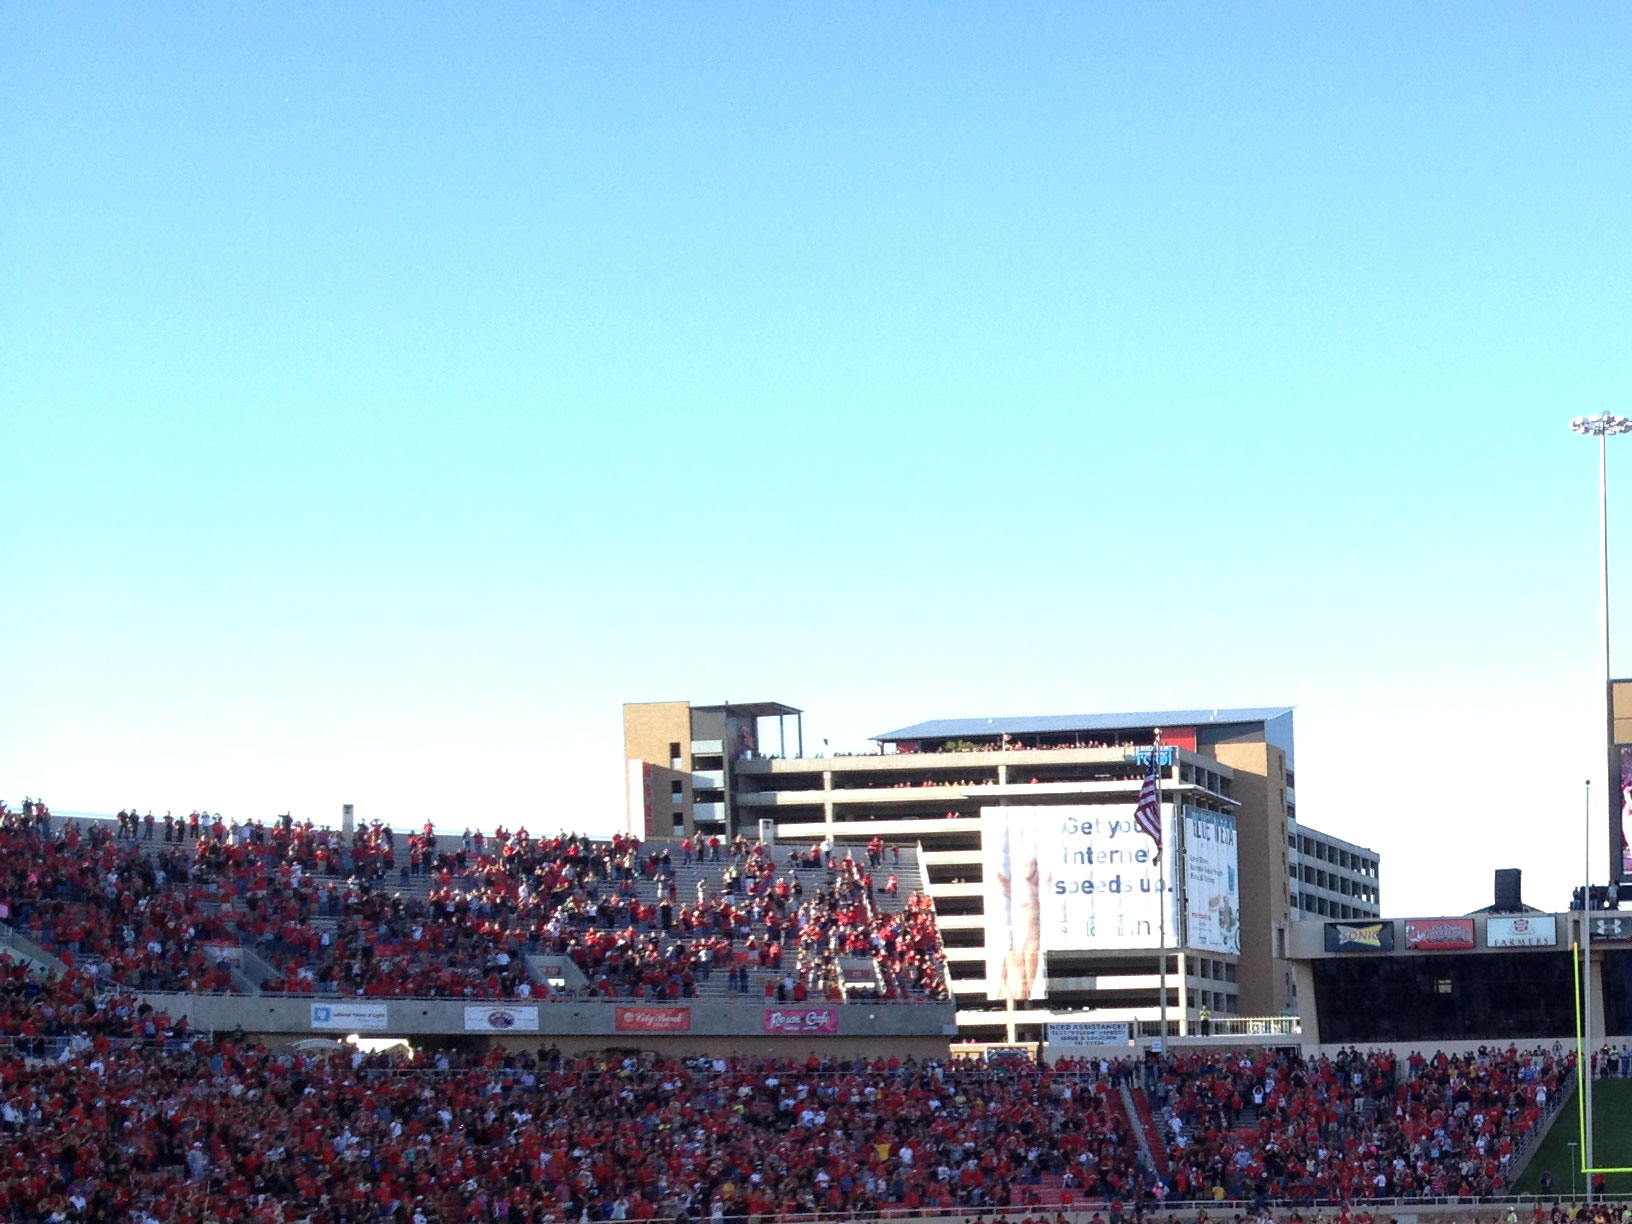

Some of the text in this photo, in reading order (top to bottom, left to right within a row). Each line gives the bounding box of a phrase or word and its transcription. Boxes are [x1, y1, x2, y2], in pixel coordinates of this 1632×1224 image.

[1062, 817, 1101, 835] Get
[1064, 847, 1150, 864] Interne
[1055, 875, 1174, 895] speeds up.
[1343, 930, 1379, 941] SONIC
[1494, 937, 1549, 947] FARMERS
